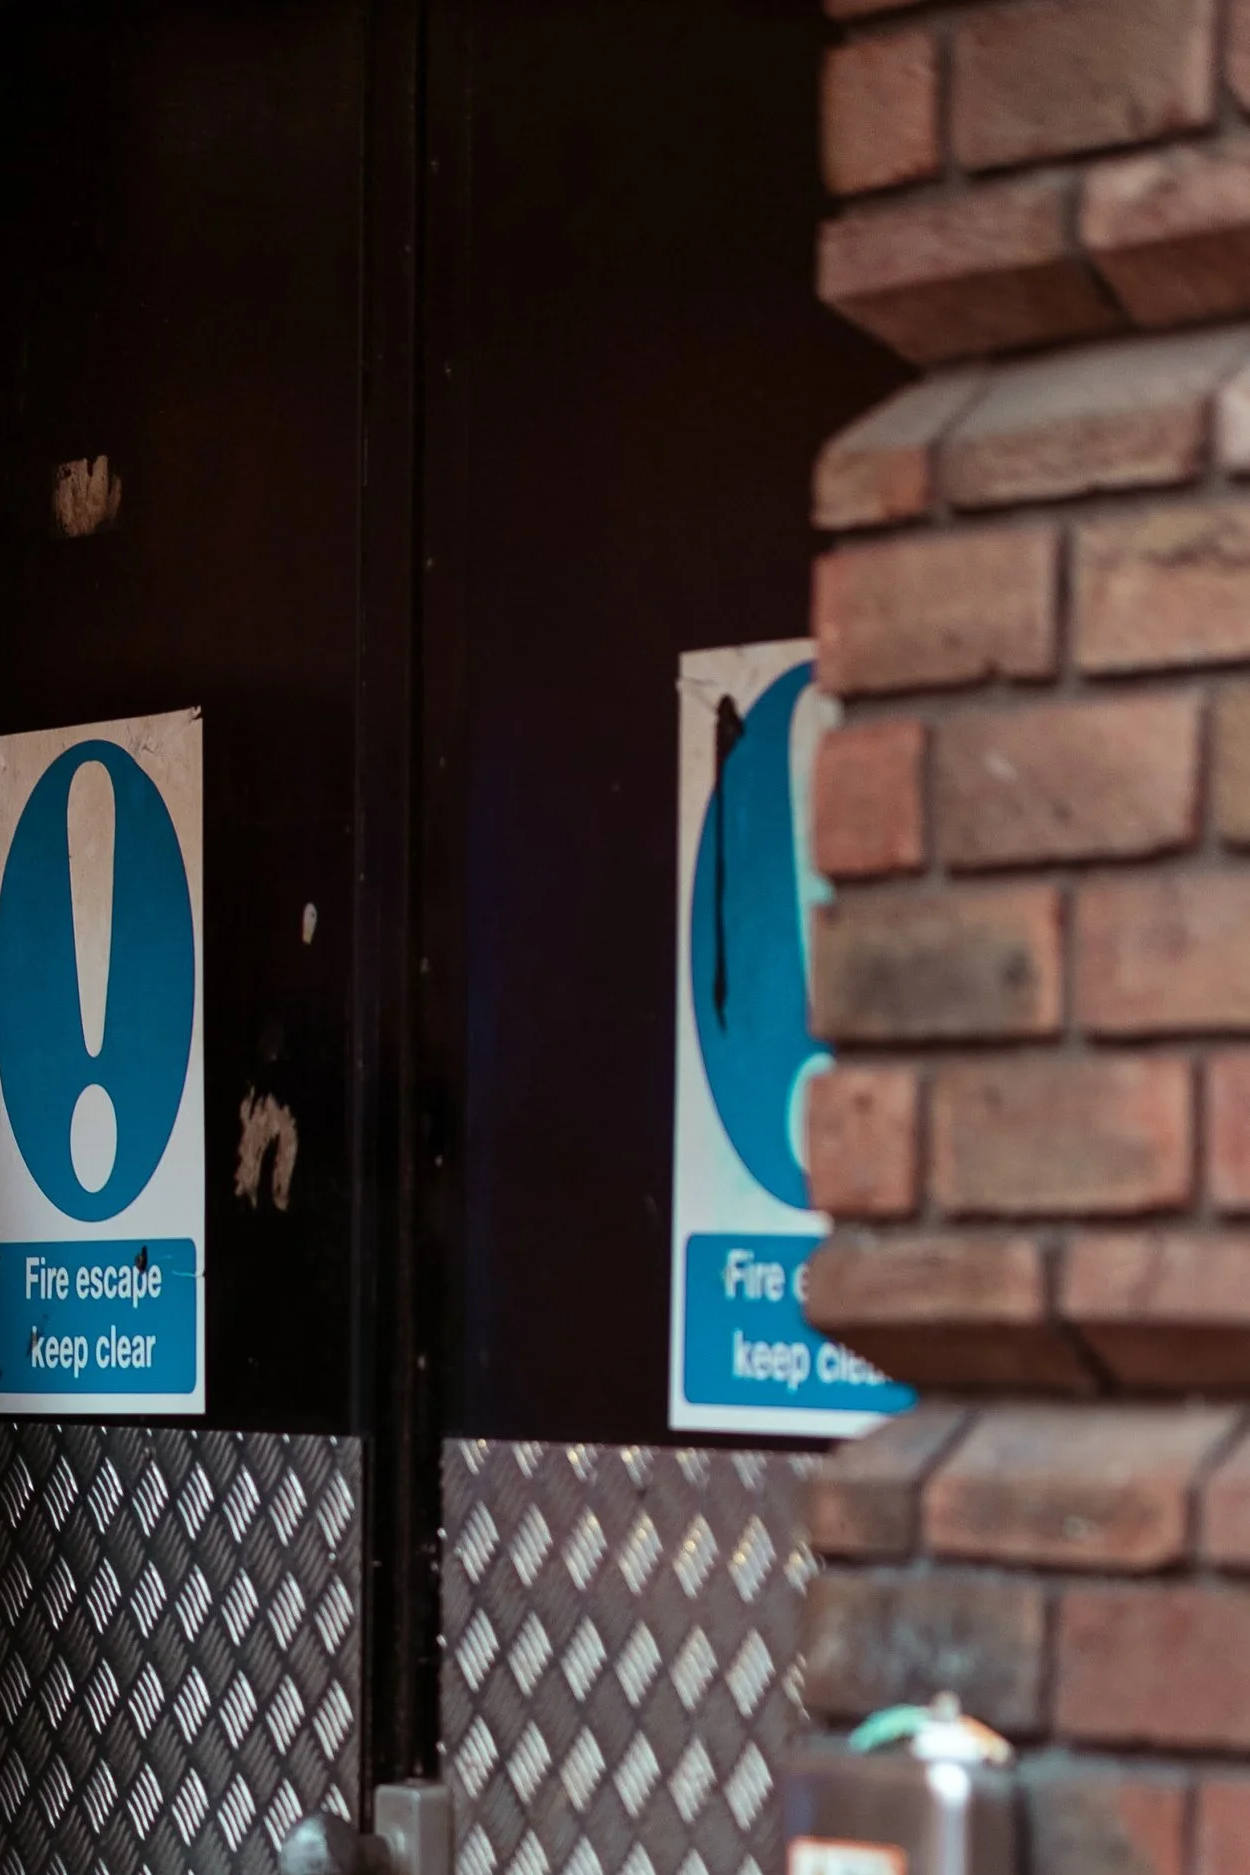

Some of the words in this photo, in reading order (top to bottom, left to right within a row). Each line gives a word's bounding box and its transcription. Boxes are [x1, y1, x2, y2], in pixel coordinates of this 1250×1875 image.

[25, 1257, 69, 1300] Fire
[76, 1264, 162, 1309] escape
[724, 1249, 785, 1301] Fire
[31, 1325, 89, 1379] keep
[96, 1324, 156, 1369] clear
[733, 1328, 811, 1391] keep
[816, 1342, 893, 1386] cle
